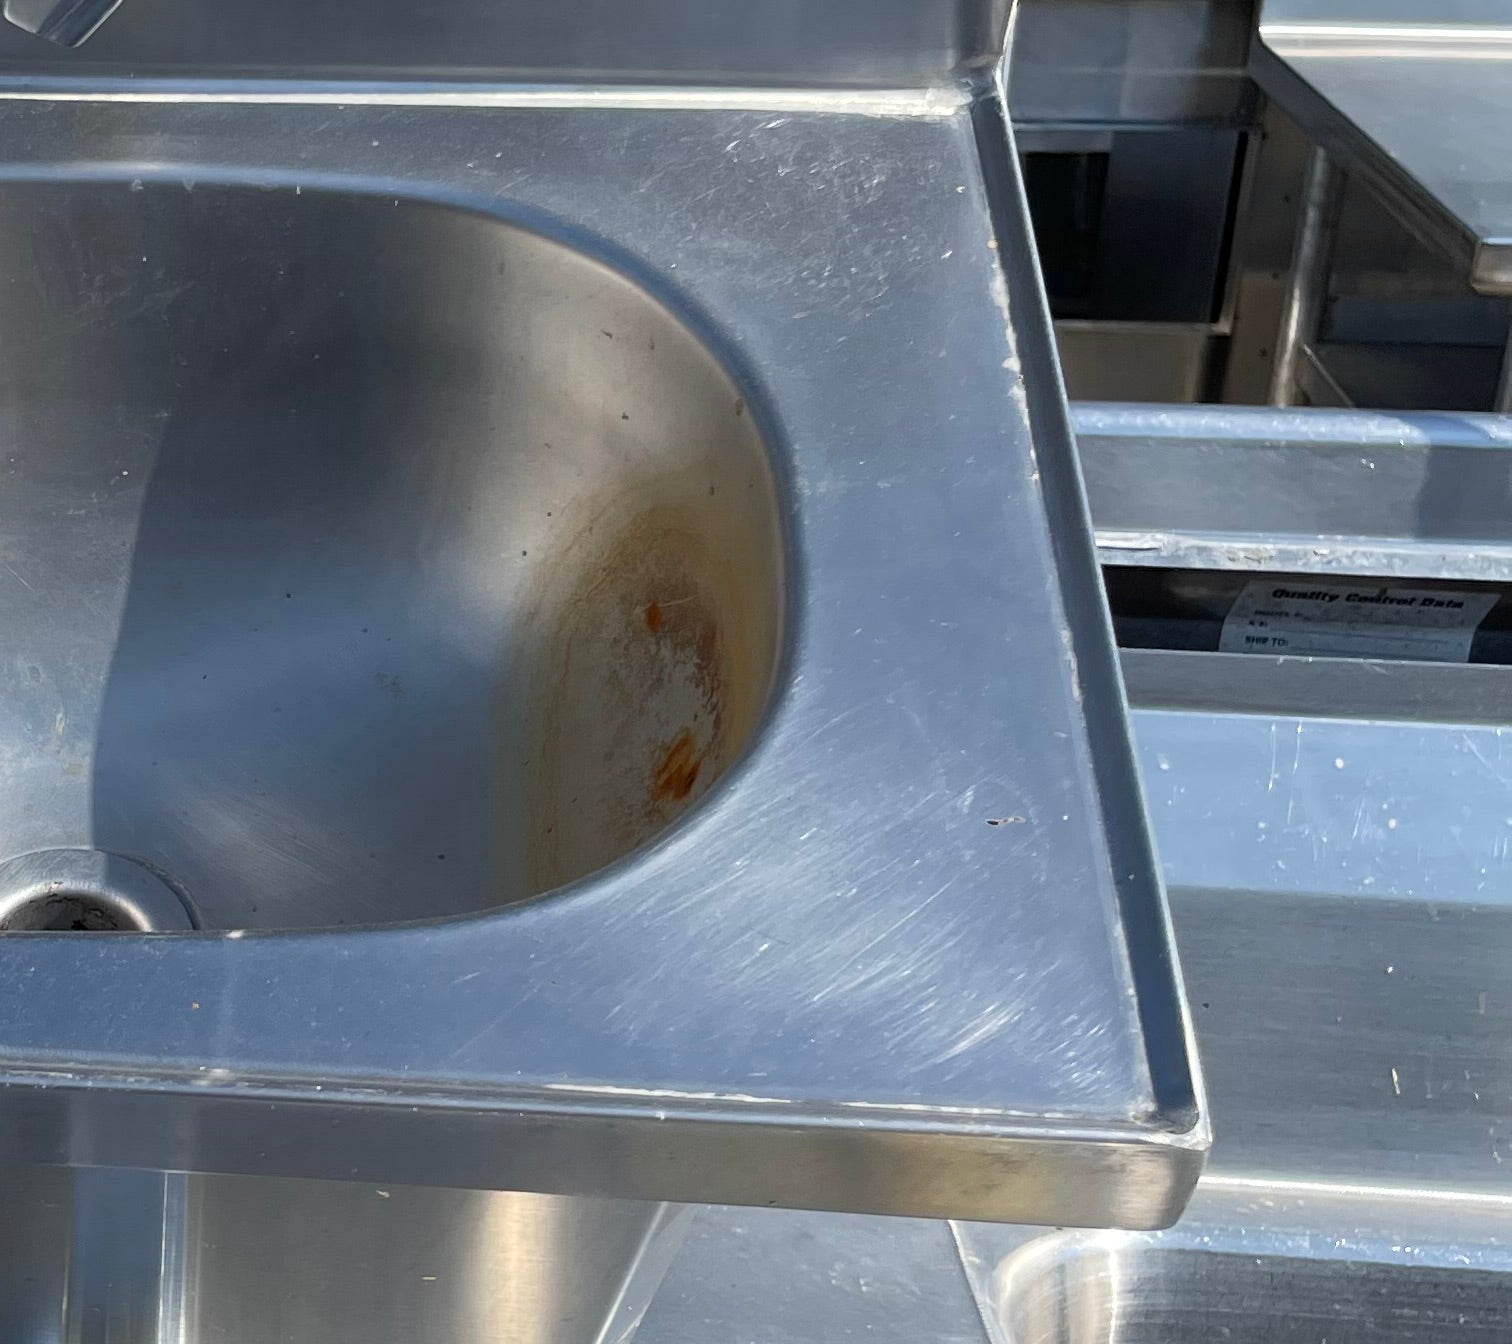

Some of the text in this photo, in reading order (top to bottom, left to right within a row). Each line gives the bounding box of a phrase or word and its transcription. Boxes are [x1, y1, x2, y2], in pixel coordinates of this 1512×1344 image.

[1272, 589, 1464, 609] Quality Control Data
